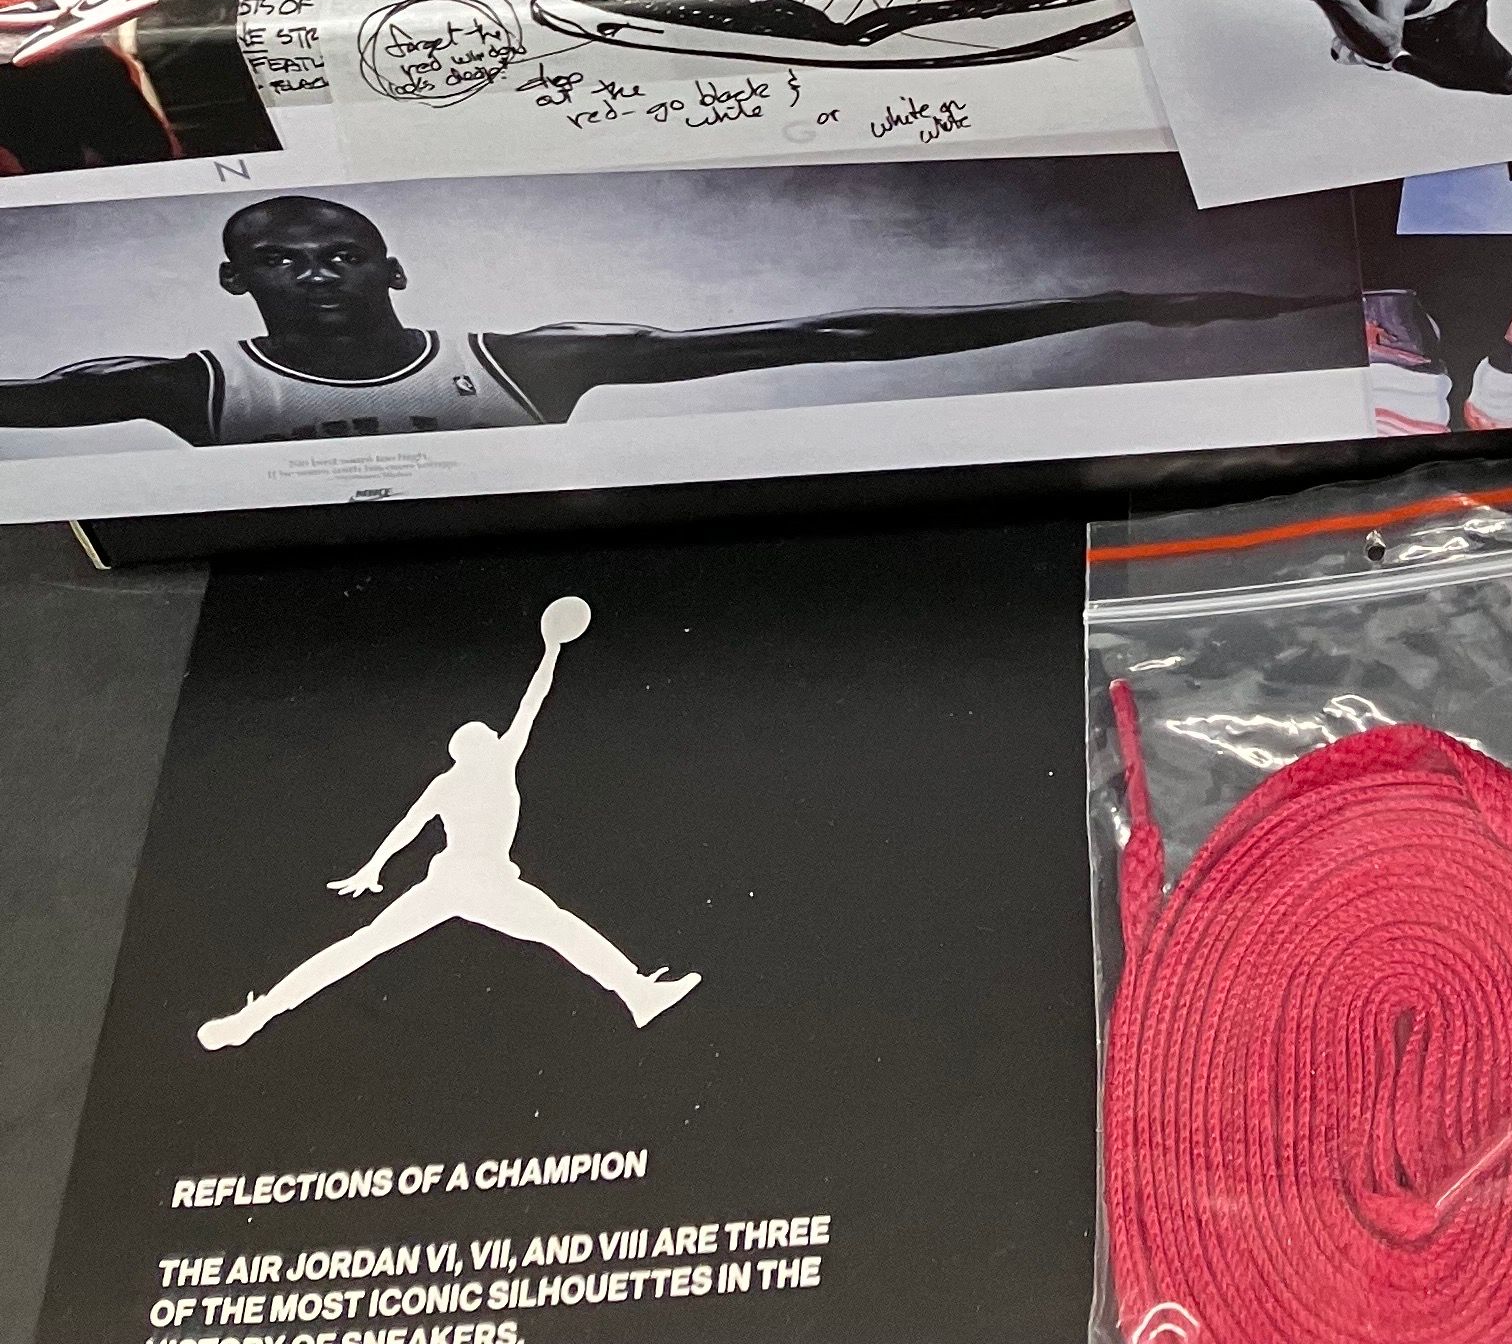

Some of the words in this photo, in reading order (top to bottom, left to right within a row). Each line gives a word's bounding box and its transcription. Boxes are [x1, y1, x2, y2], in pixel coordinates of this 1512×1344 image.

[385, 21, 463, 59] forget
[591, 79, 645, 100] the
[646, 100, 685, 122] go
[695, 78, 771, 107] black
[686, 104, 764, 128] white
[816, 109, 841, 125] or
[870, 96, 930, 138] white
[171, 1168, 394, 1208] REFLECTIONS
[397, 1163, 444, 1195] OF
[446, 1162, 471, 1193] A
[474, 1149, 648, 1190] CHAMPION
[159, 1256, 225, 1287] THE
[226, 1254, 283, 1284] AIR
[286, 1244, 421, 1281] JORDAN
[425, 1242, 464, 1277] VI,
[470, 1238, 517, 1274] VII,
[521, 1233, 594, 1268] AND
[598, 1228, 650, 1261] VIII
[650, 1223, 720, 1257] ARE
[724, 1214, 831, 1252] THREE
[149, 1298, 198, 1328] OF
[200, 1294, 267, 1326] THE
[269, 1290, 366, 1323] MOST
[367, 1281, 483, 1318] ICONIC
[486, 1265, 714, 1310] SILHOUETTES
[717, 1261, 752, 1294] IN
[756, 1256, 823, 1290] THE
